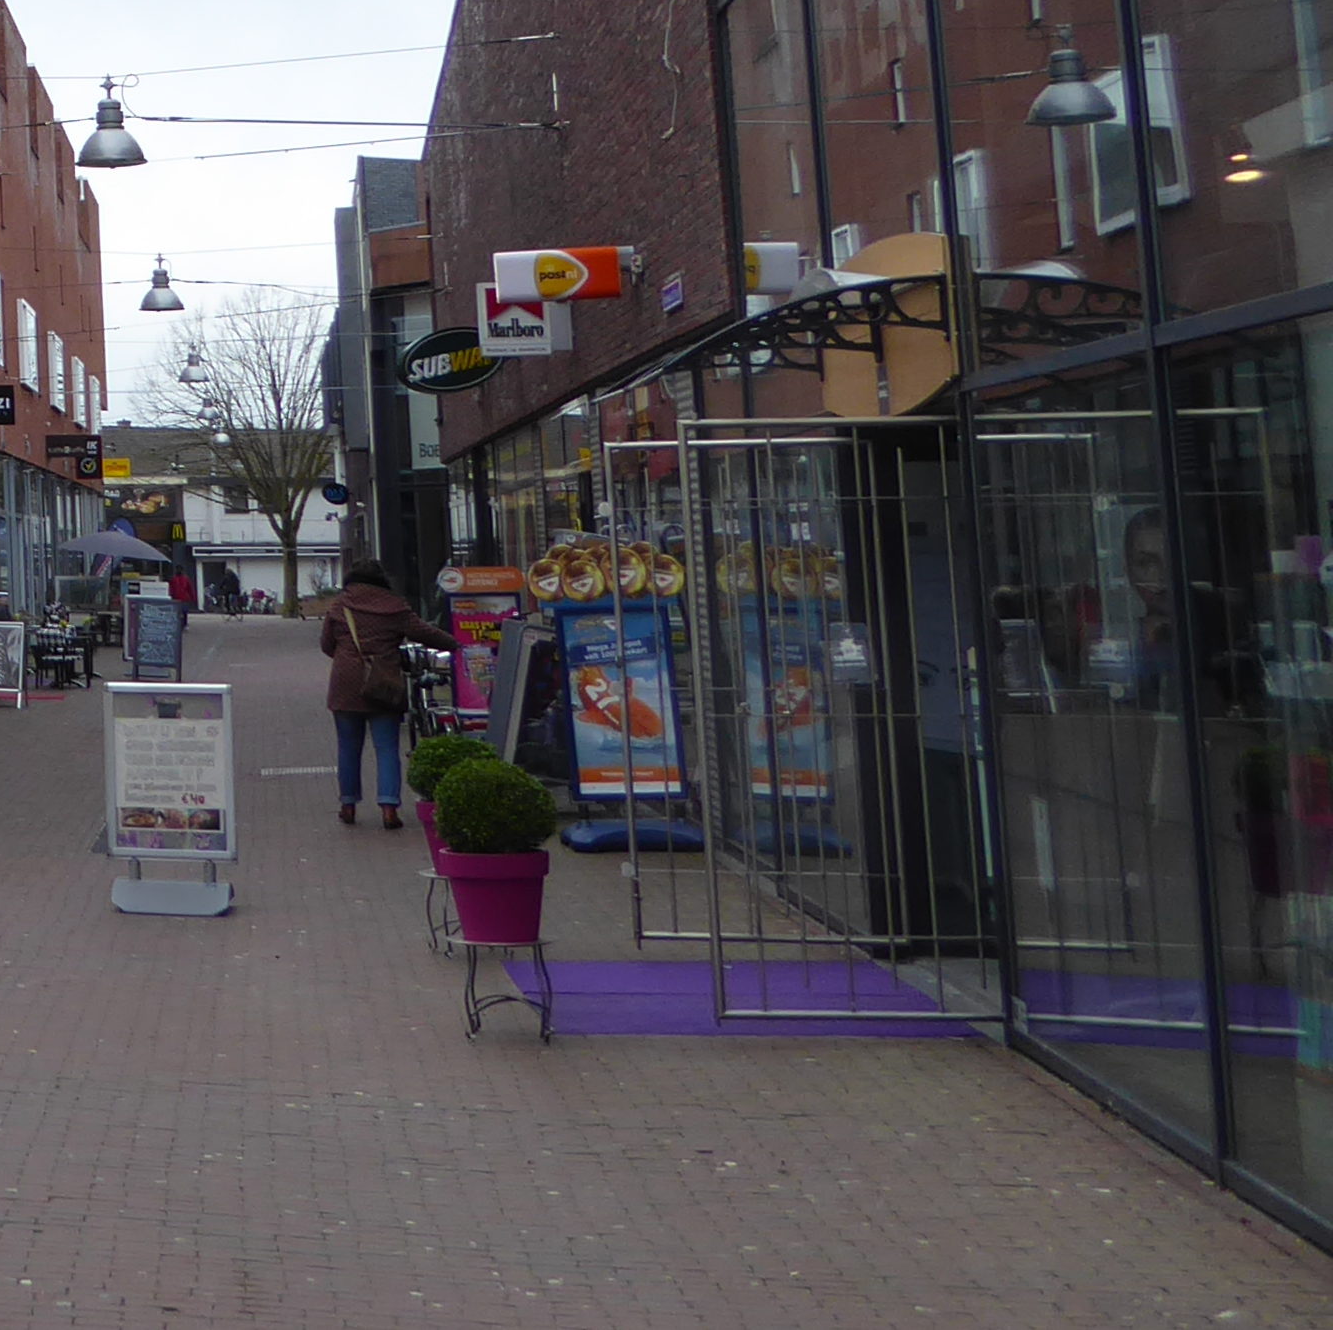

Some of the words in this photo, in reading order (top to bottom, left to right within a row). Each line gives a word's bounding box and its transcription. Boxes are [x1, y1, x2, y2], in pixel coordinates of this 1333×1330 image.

[538, 268, 578, 282] postnl
[487, 318, 545, 338] Marlboro
[407, 345, 495, 383] SUBWA
